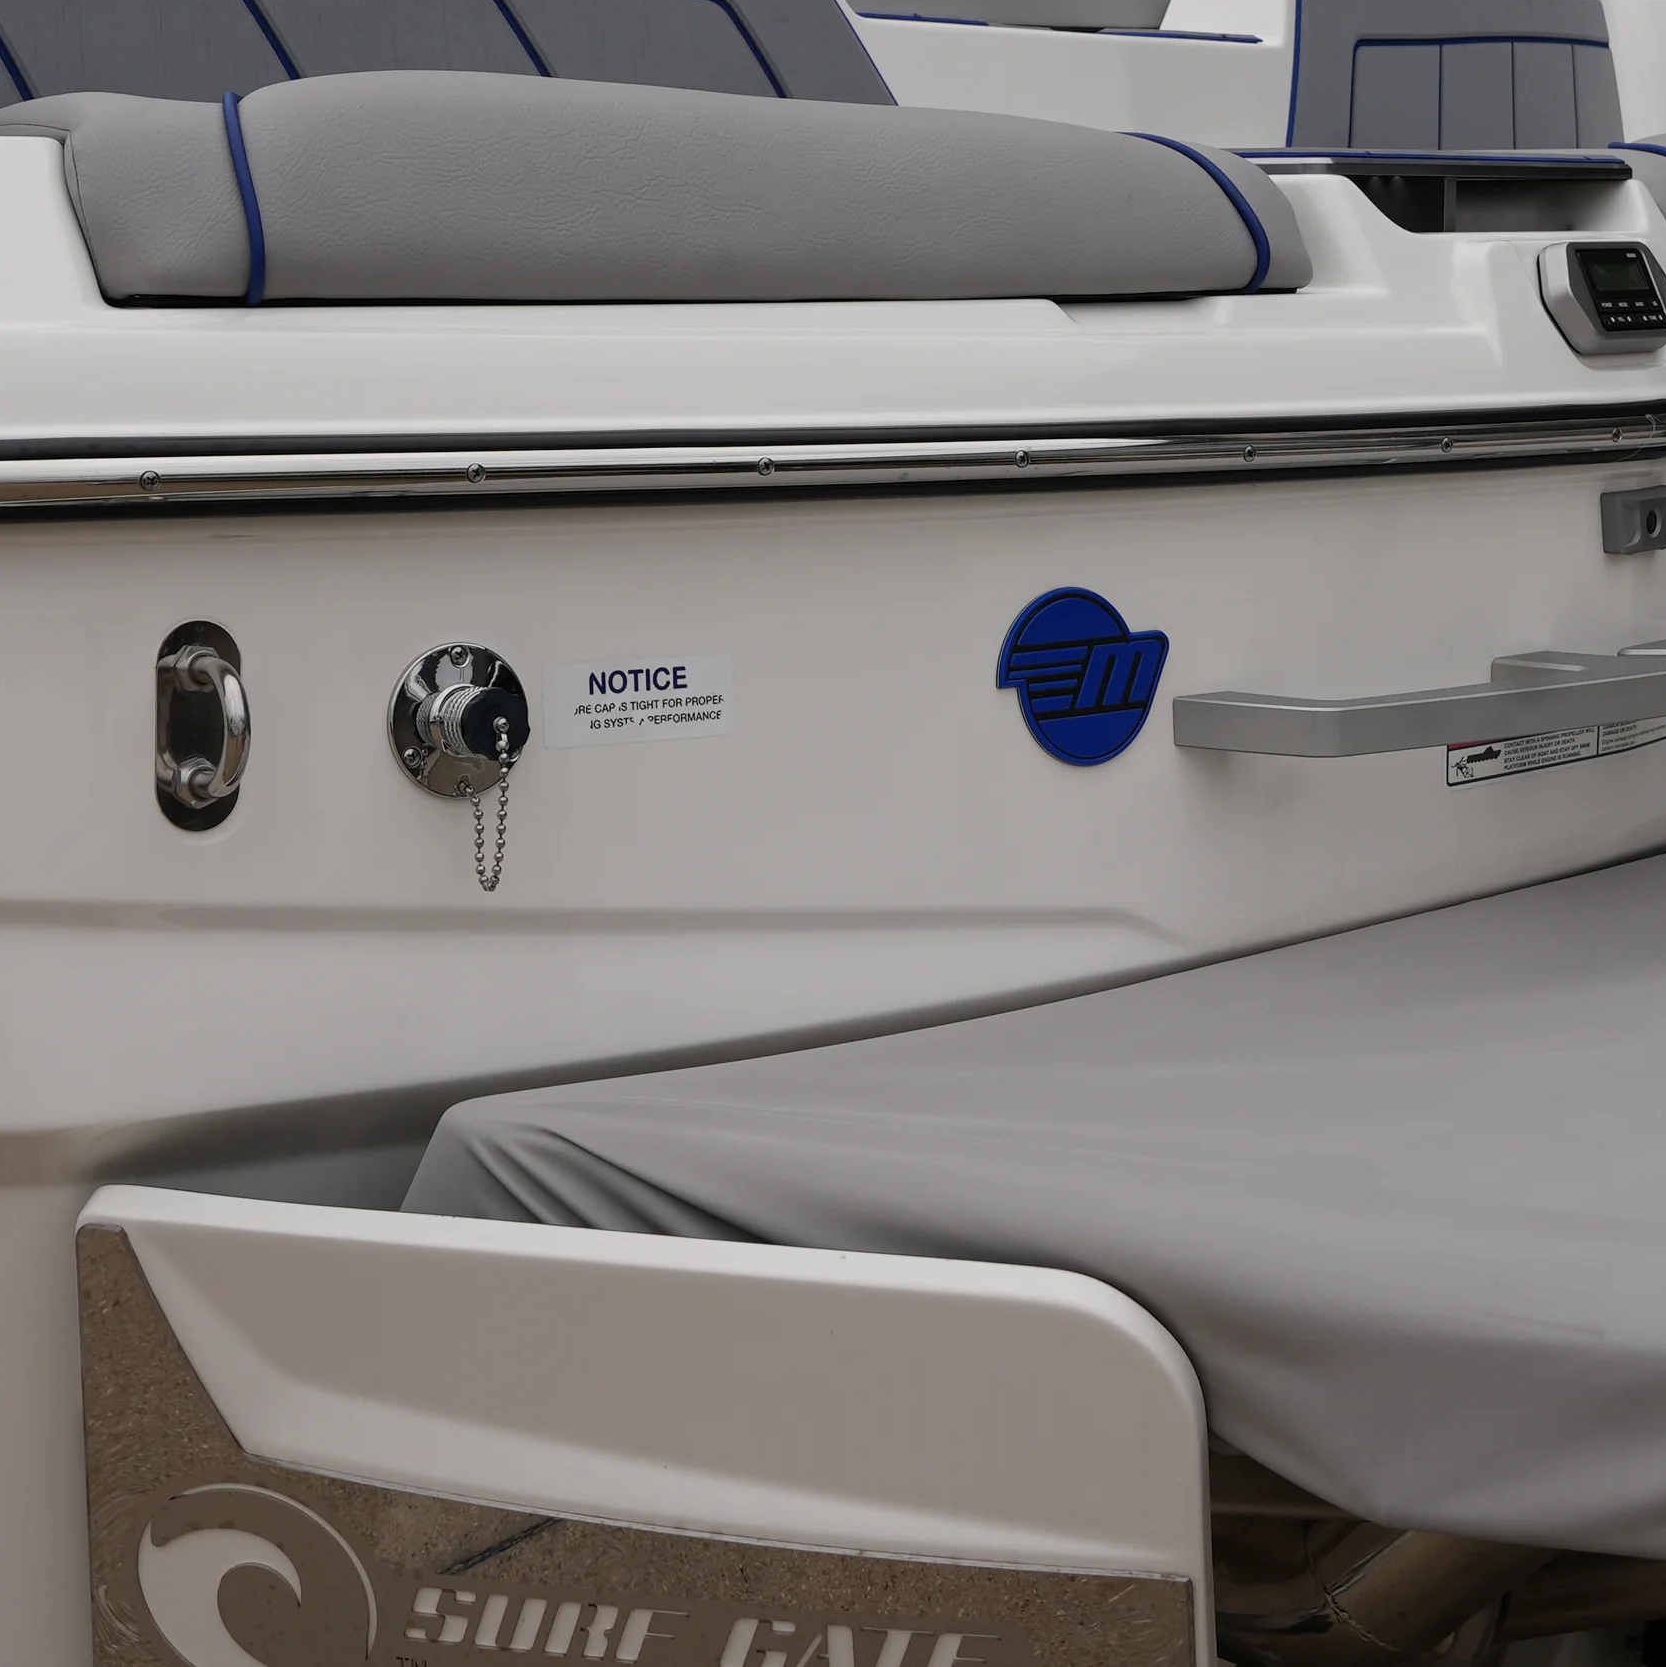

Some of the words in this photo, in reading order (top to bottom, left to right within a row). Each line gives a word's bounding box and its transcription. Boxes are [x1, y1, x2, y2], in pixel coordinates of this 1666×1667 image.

[588, 666, 688, 695] NOTICE
[594, 702, 616, 714] CAP
[630, 699, 660, 711] TIGHT
[662, 697, 683, 709] FOR
[685, 694, 724, 707] PROPER
[404, 1586, 691, 1665] SURF
